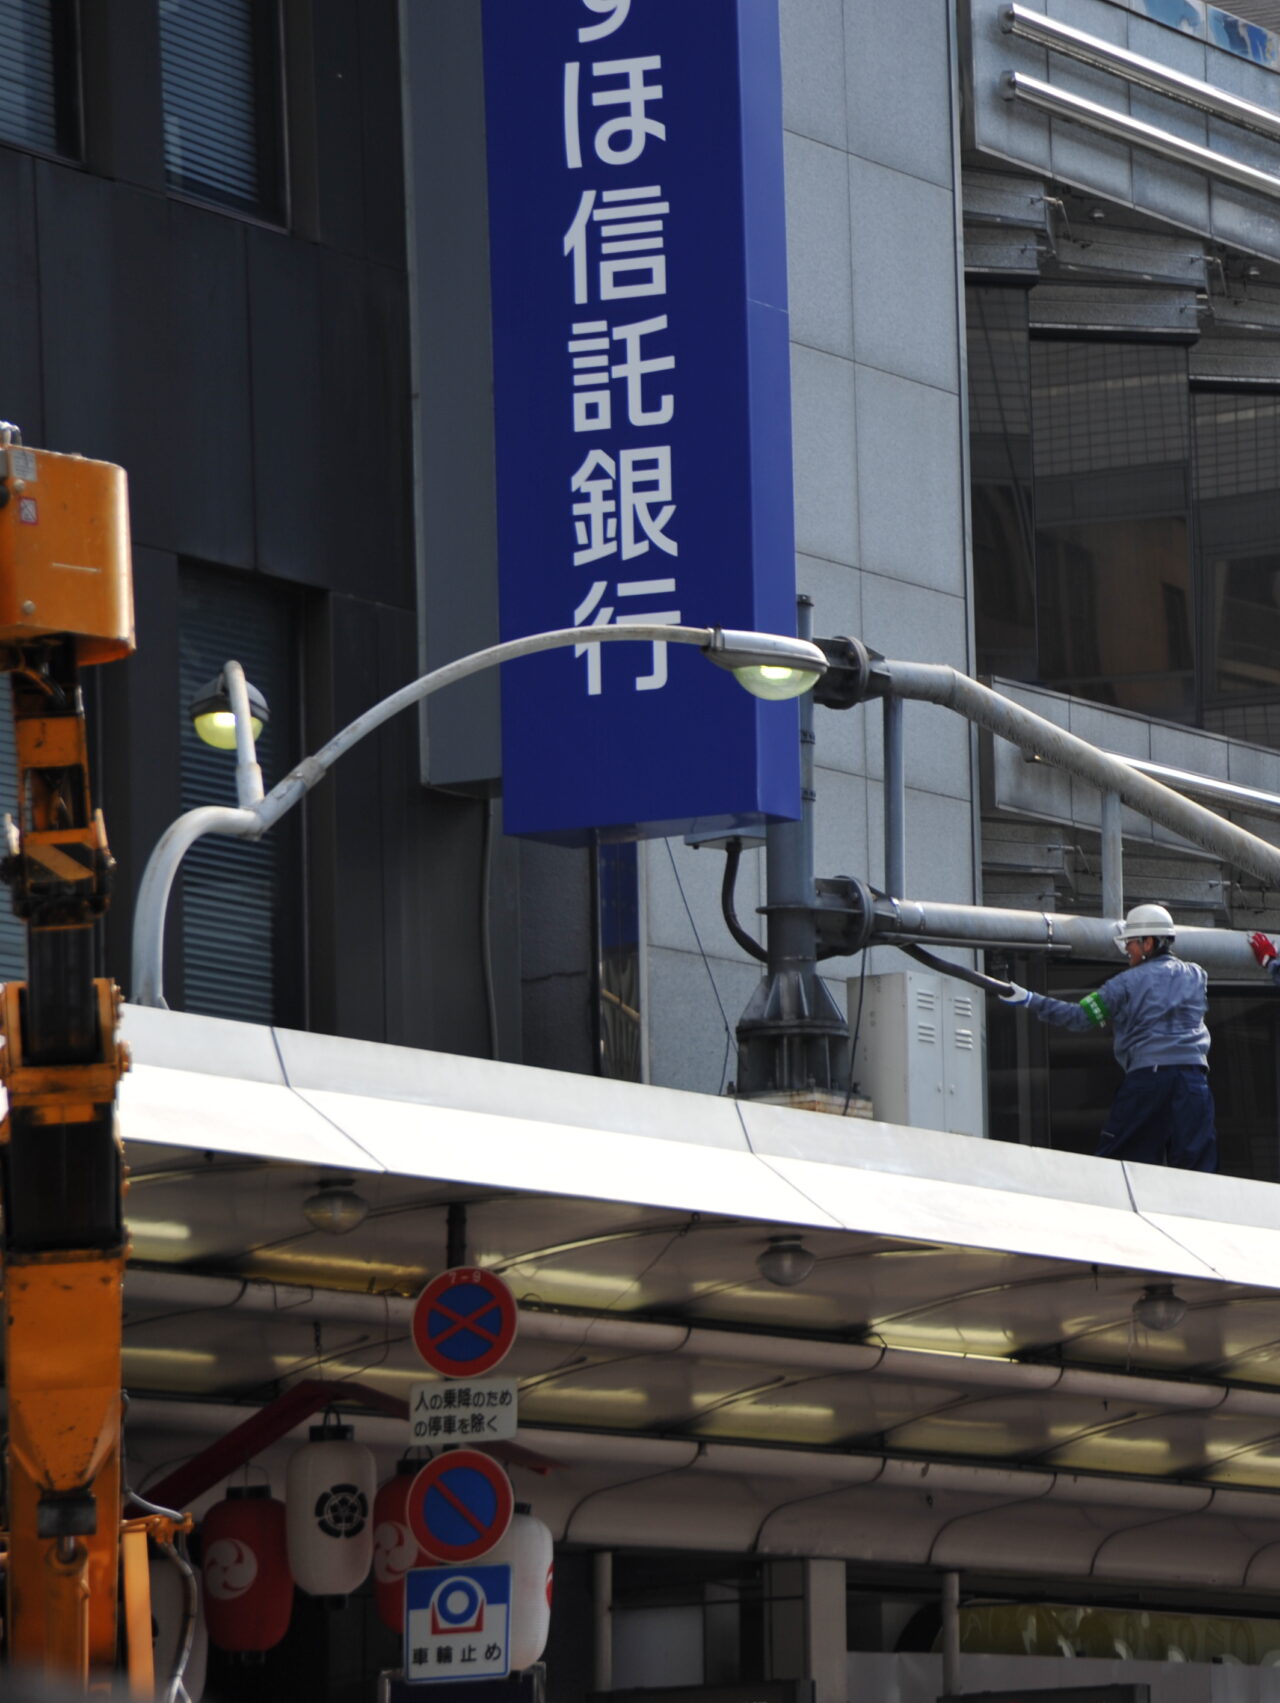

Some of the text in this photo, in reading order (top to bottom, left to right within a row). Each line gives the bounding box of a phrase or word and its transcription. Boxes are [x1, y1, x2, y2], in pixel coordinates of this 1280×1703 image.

[415, 1388, 513, 1412] 人の乗降のため
[414, 1413, 498, 1437] の停車を除く
[412, 1642, 502, 1666] 車輪止め
